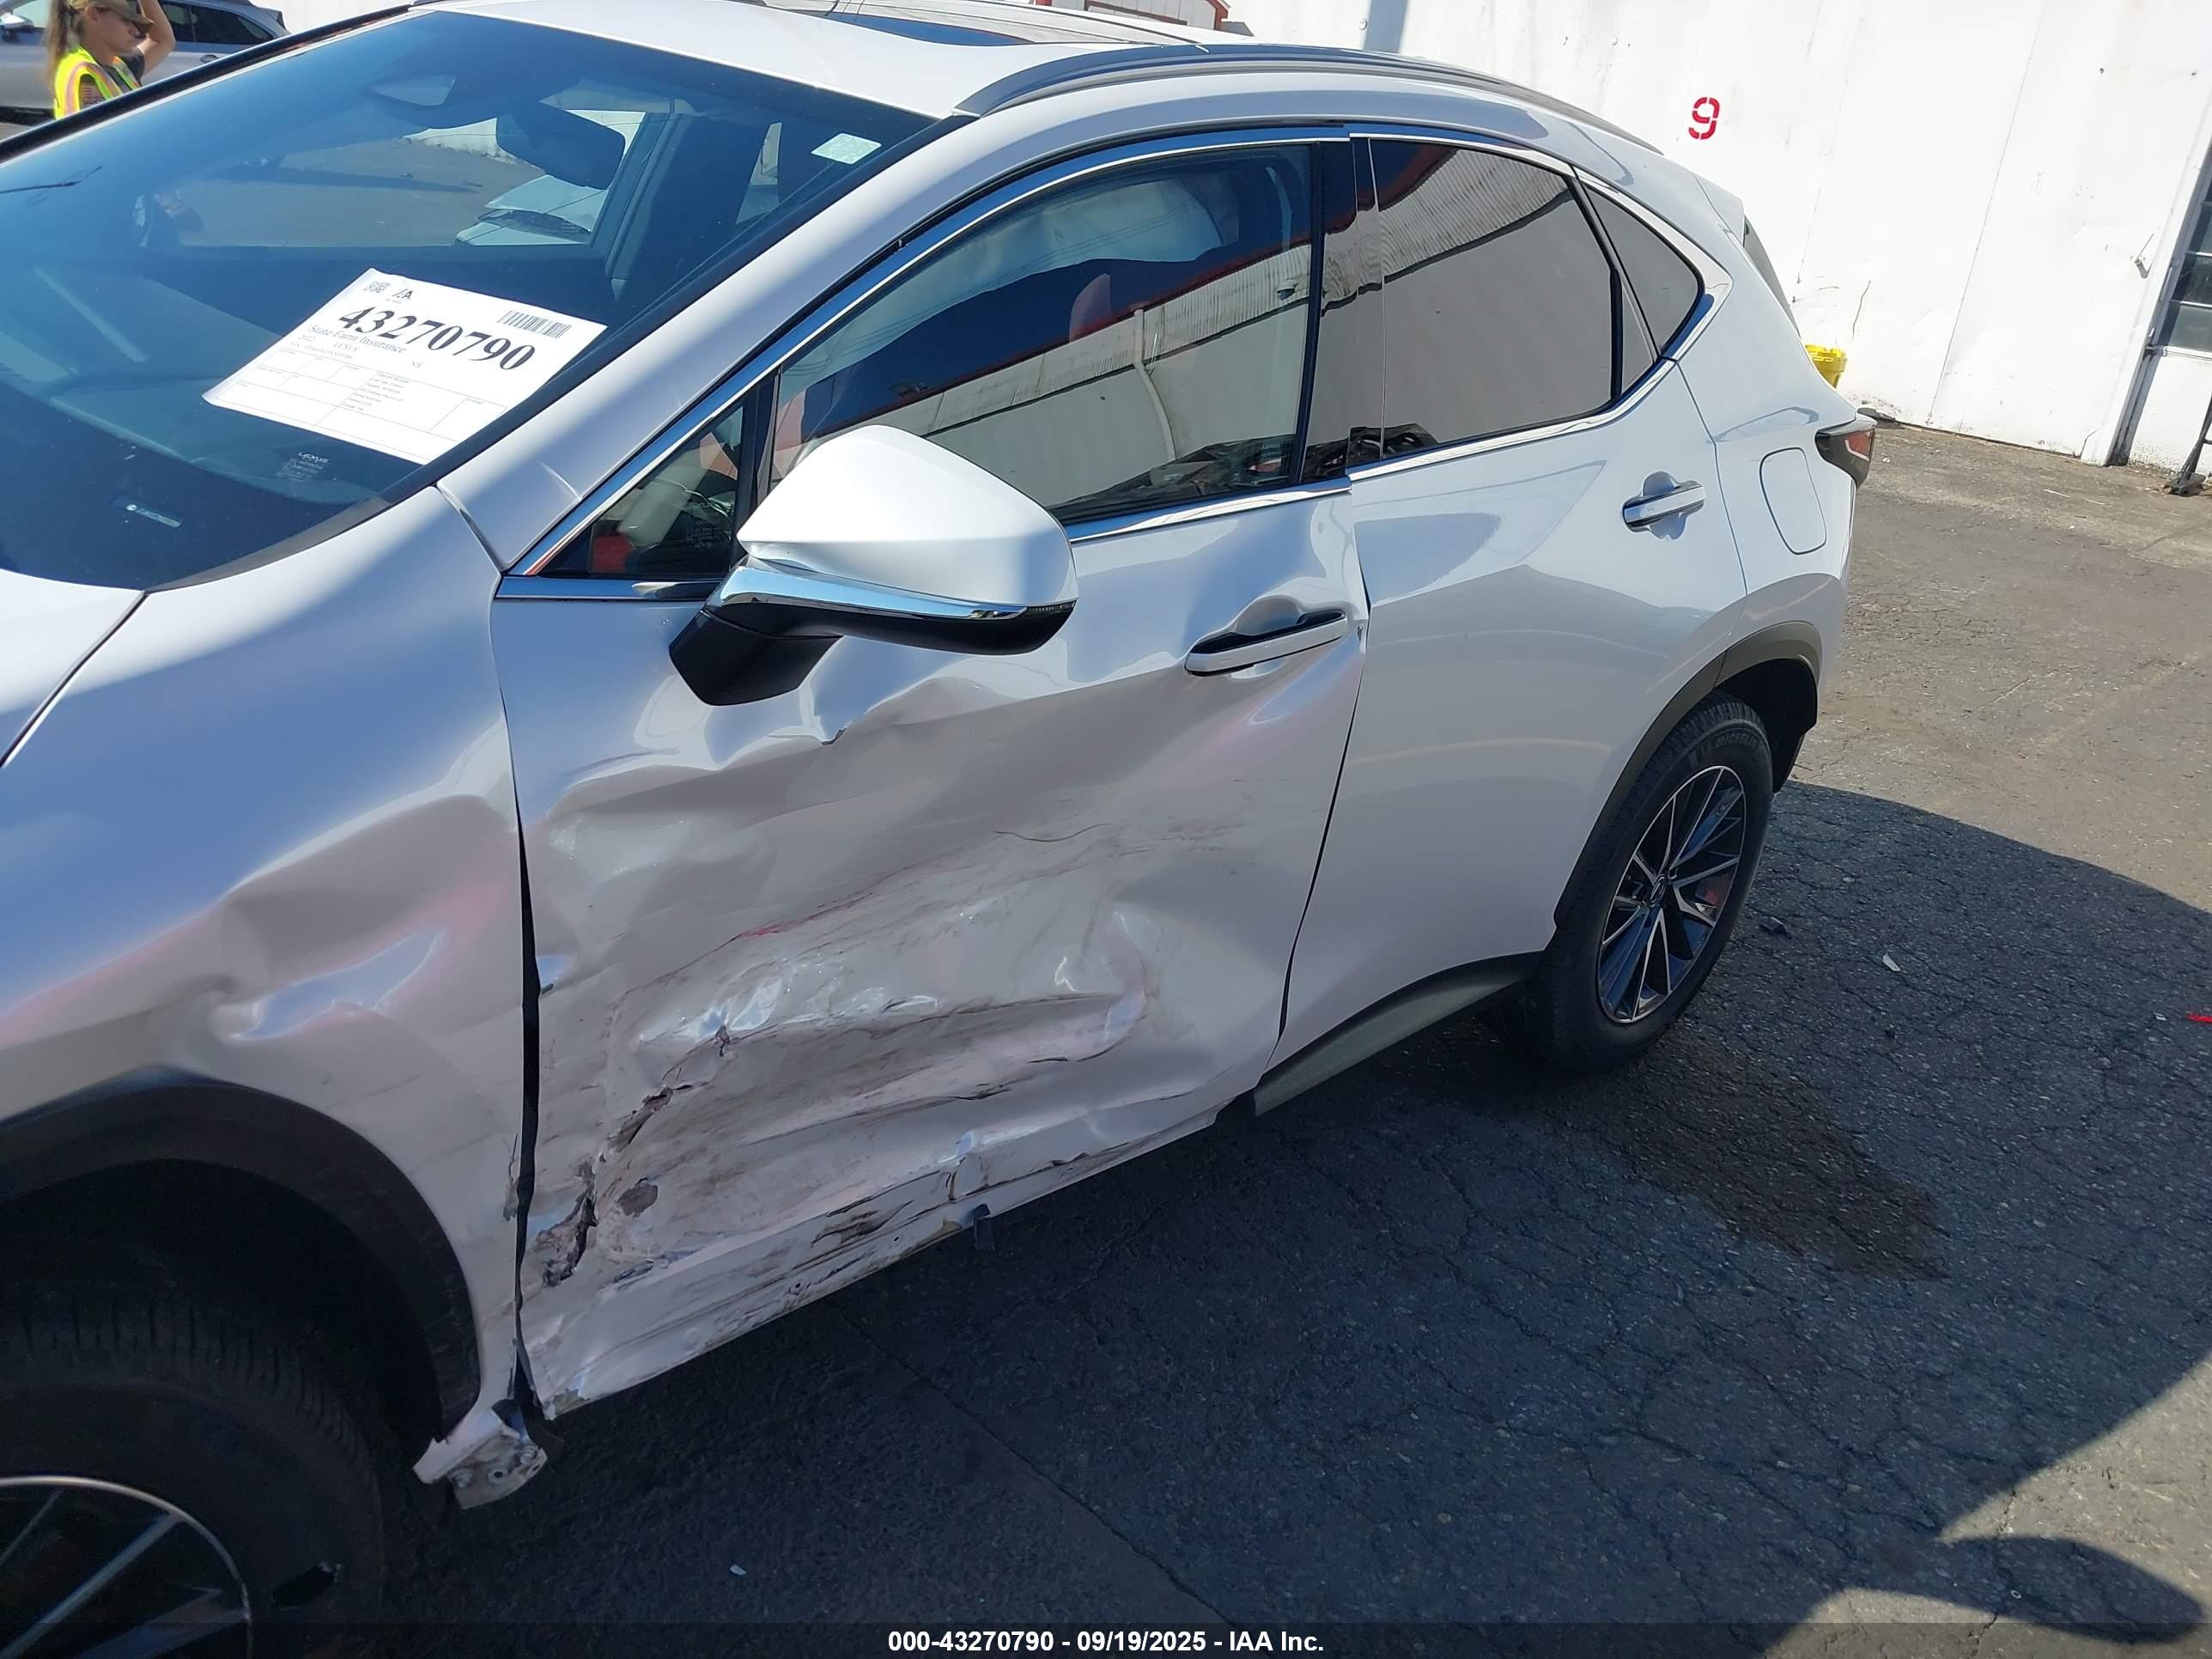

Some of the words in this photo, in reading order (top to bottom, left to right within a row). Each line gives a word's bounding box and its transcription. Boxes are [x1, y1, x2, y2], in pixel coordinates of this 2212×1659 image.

[1688, 96, 1720, 140] 9
[307, 325, 333, 337] State
[332, 329, 357, 342] Farm
[359, 336, 406, 354] Insurance
[338, 307, 536, 370] 43270790
